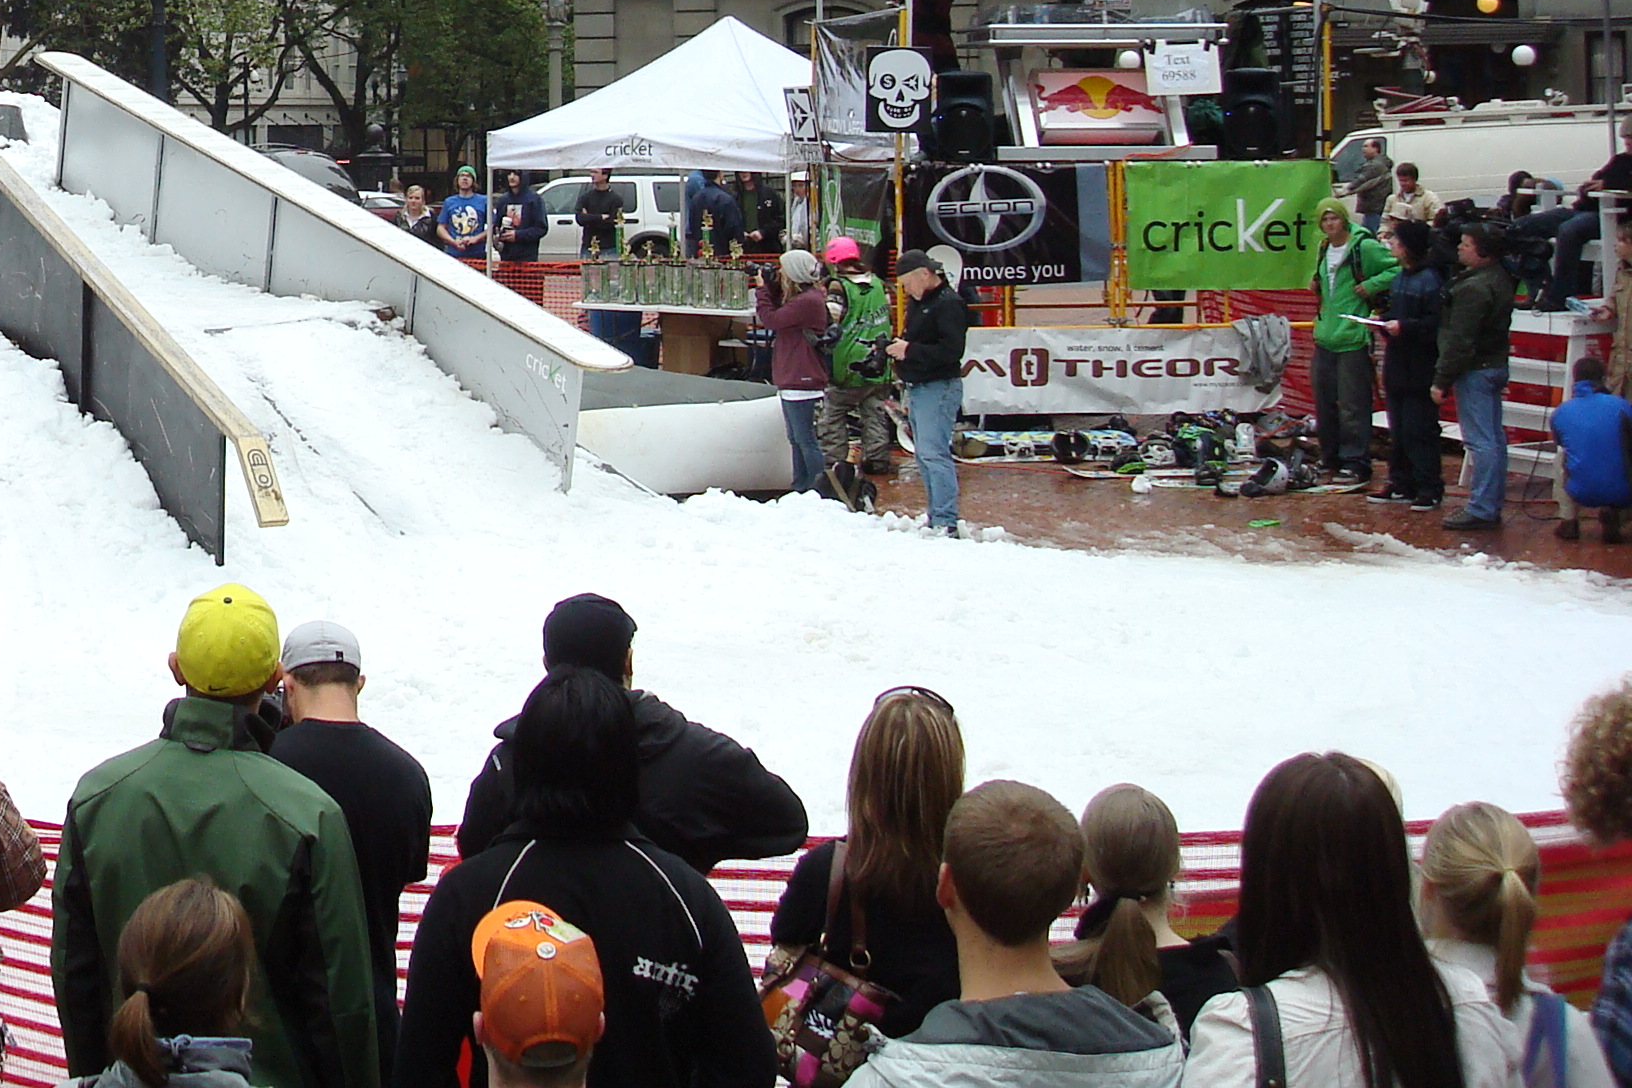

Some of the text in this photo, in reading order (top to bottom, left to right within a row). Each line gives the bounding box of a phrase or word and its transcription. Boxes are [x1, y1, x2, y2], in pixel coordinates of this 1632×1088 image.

[1164, 54, 1191, 66] Text
[1161, 70, 1197, 82] 69588
[604, 137, 653, 156] cricket
[1143, 198, 1307, 253] cricket
[963, 264, 1065, 283] moves you
